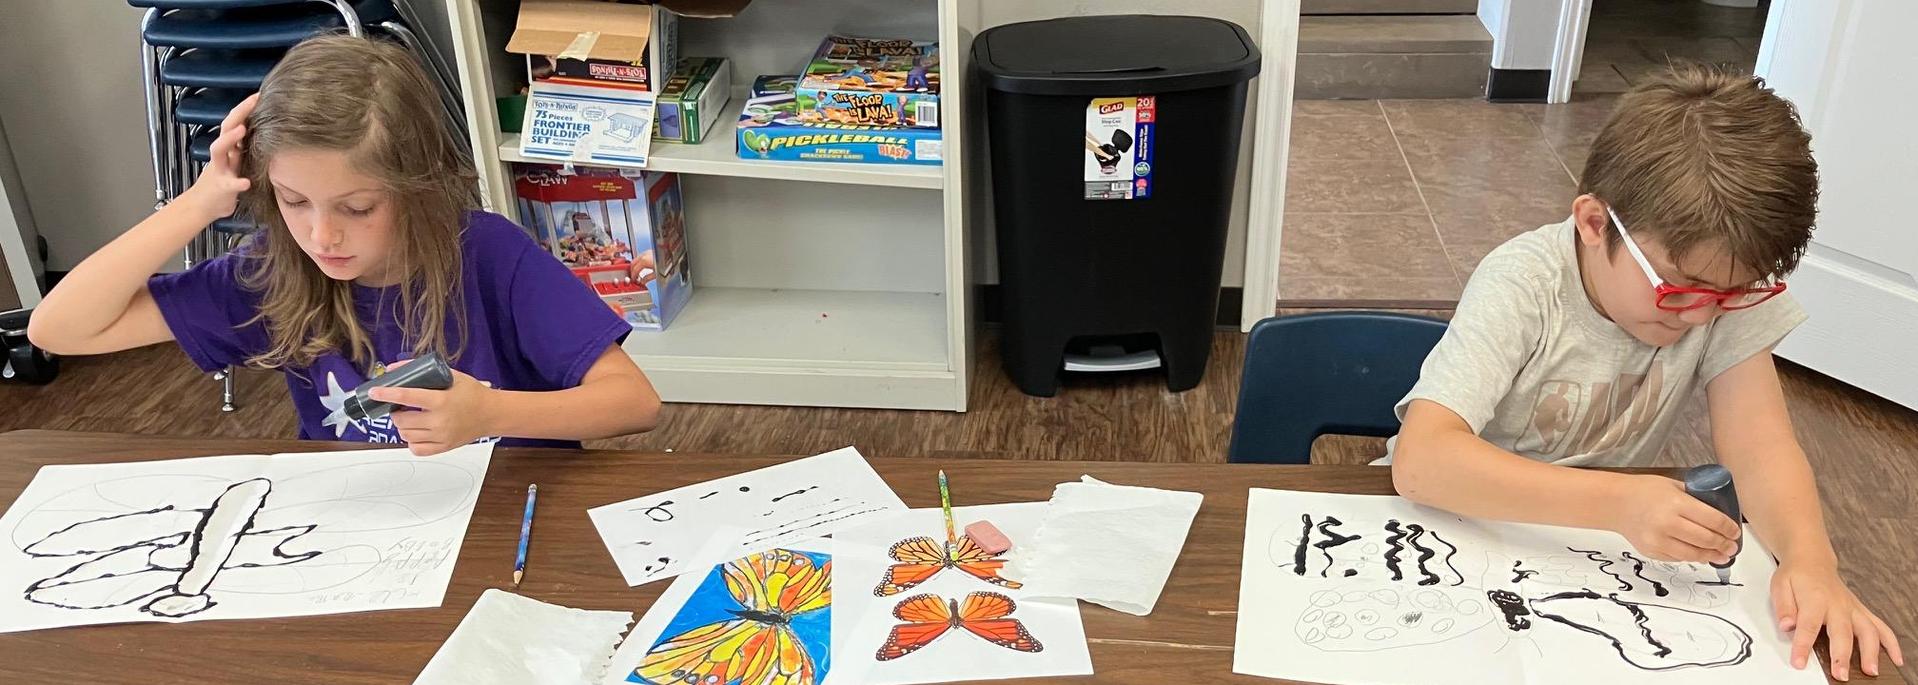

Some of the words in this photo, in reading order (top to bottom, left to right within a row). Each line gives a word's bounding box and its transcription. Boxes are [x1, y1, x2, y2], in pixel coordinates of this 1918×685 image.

[833, 93, 849, 103] THE
[848, 94, 883, 108] FLOOR
[1137, 98, 1149, 107] 20
[857, 104, 893, 121] LAVA!
[1101, 103, 1123, 114] GLAD
[536, 110, 548, 119] 75
[549, 113, 573, 121] Pieces
[533, 119, 590, 132] FRONTIER
[531, 135, 552, 144] SET
[769, 134, 908, 150] PICKLEBALL
